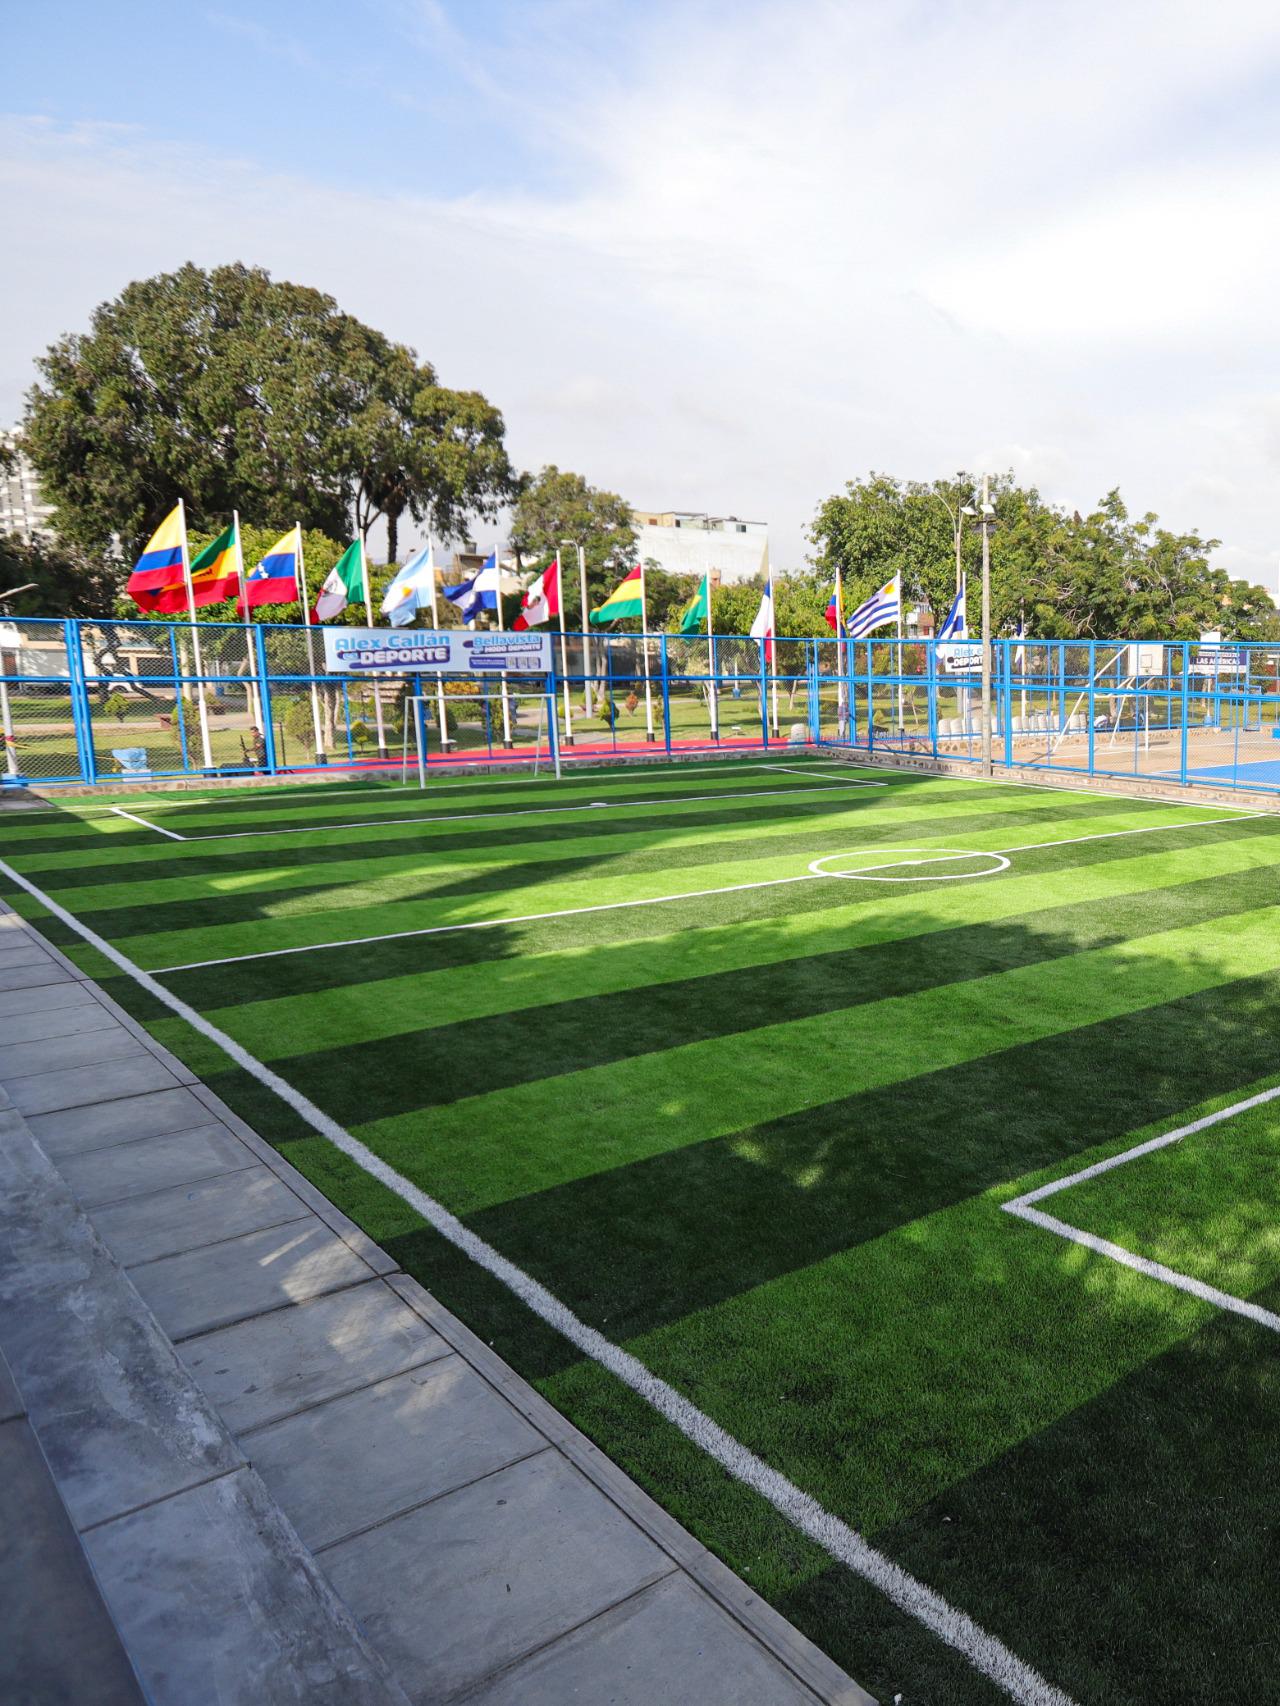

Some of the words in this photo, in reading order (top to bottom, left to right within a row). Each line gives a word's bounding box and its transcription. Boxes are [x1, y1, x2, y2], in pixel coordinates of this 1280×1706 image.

[335, 637, 381, 651] Alex
[386, 633, 450, 648] Callán
[474, 635, 541, 647] Bellavista
[360, 647, 448, 665] DEPORTE
[954, 647, 974, 656] Alex
[953, 656, 984, 666] DEPORT
